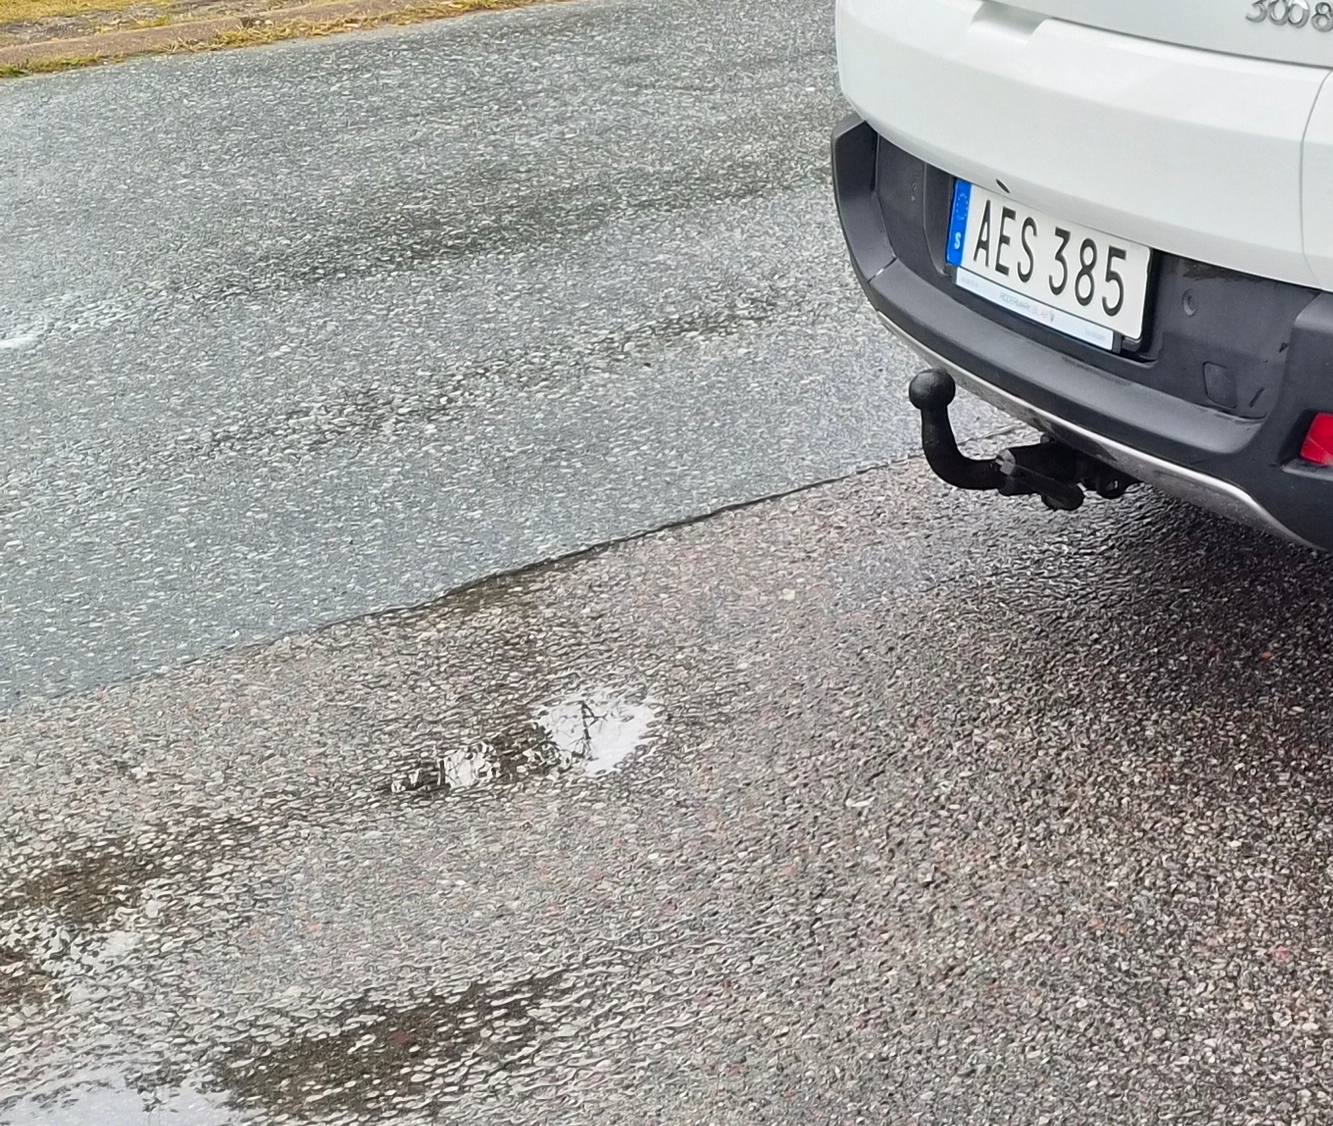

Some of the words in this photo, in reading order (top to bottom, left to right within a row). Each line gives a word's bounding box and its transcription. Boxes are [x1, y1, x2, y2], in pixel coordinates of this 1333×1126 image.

[953, 231, 961, 250] S
[973, 199, 1037, 283] AES
[1048, 225, 1127, 317] 385
